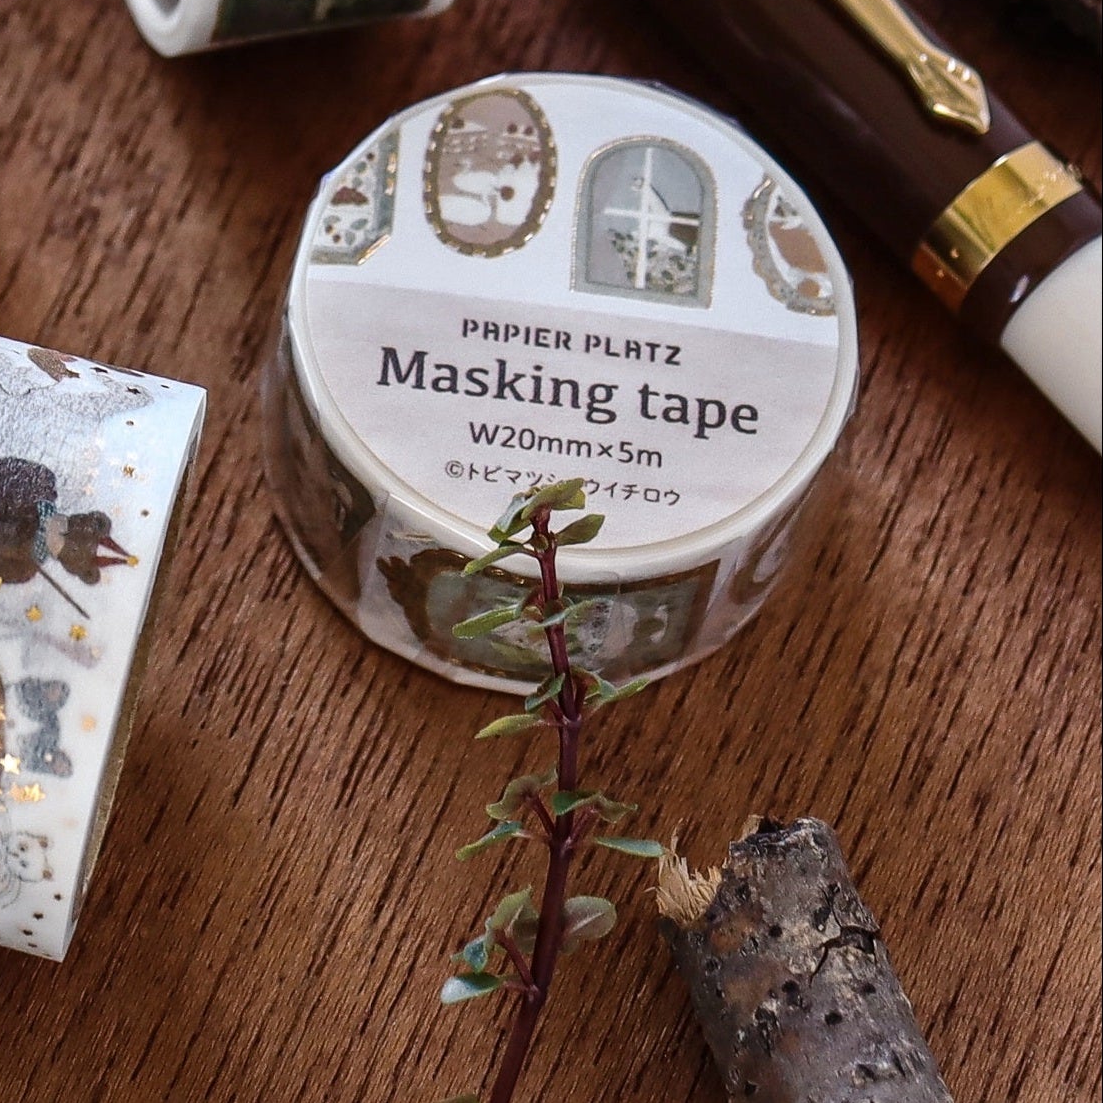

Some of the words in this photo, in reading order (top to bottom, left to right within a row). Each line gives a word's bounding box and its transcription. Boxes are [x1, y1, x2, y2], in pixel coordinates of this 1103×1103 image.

[462, 318, 572, 351] PAPIER
[584, 334, 681, 366] PLATZ
[376, 346, 619, 425] Masking
[638, 382, 759, 439] tape
